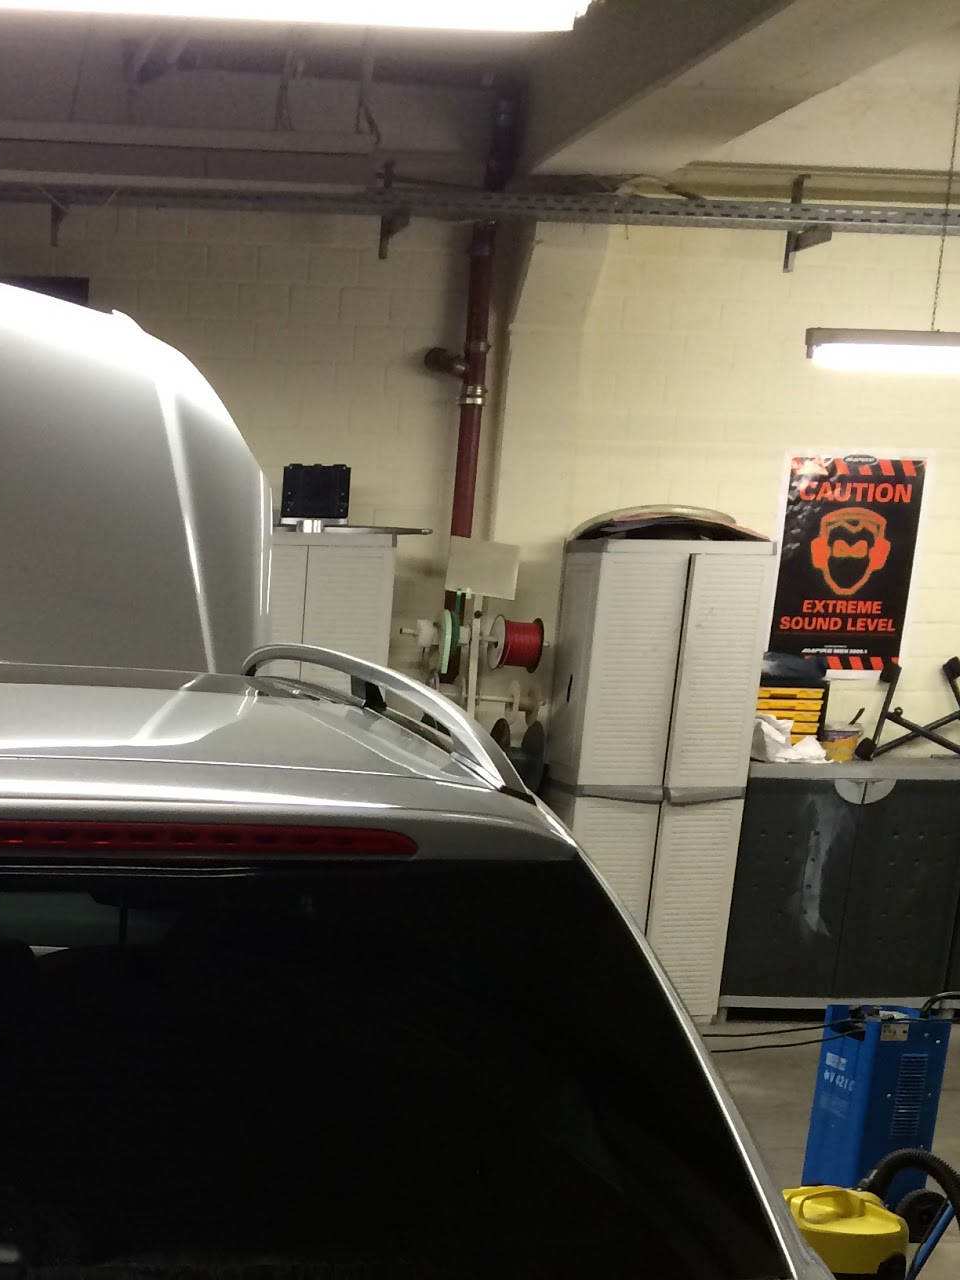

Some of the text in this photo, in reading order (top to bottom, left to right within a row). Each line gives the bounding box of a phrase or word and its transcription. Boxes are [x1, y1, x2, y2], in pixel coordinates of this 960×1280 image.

[799, 481, 913, 503] CAUTION
[802, 600, 882, 614] EXTREME
[779, 616, 896, 632] SOUND LEVEL
